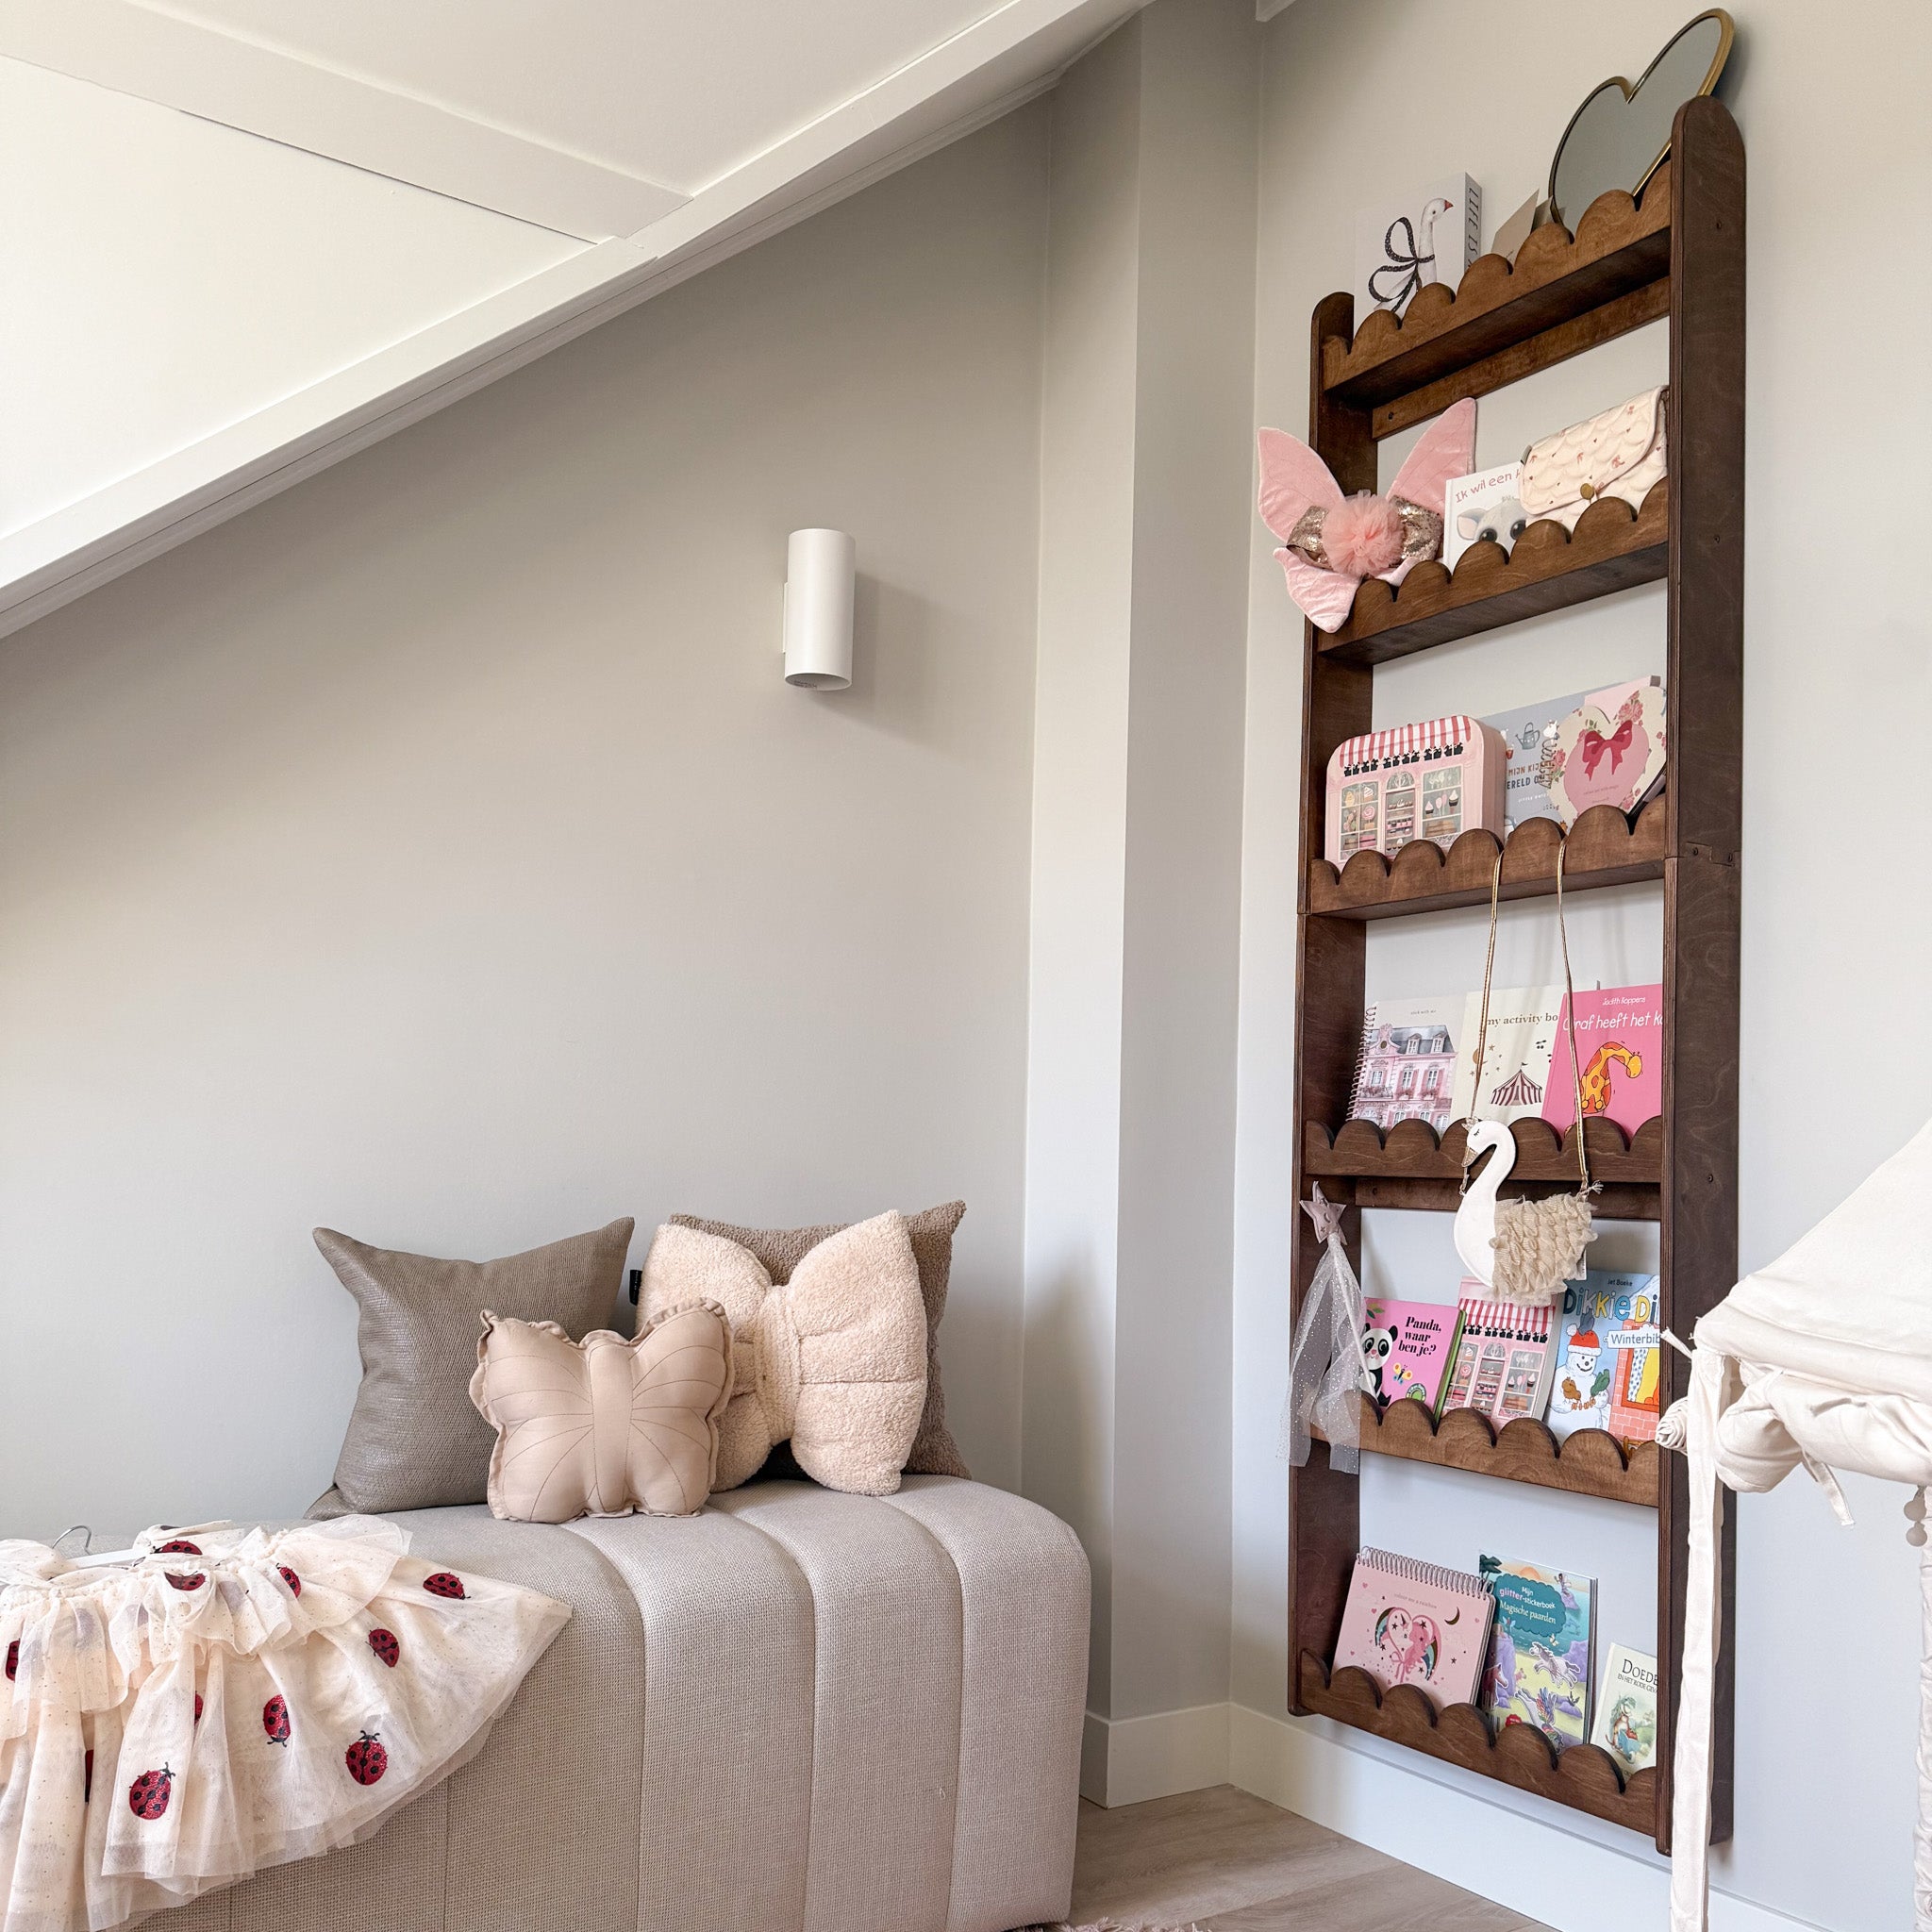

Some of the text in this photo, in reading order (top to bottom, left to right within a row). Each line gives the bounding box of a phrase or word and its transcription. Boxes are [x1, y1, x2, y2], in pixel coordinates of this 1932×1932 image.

[1468, 188, 1479, 230] LIFE
[1468, 234, 1478, 256] IS
[1455, 490, 1468, 503] Ik
[1470, 479, 1487, 494] wil
[1488, 473, 1512, 487] een
[1507, 762, 1540, 777] MIJN KIJ
[1507, 776, 1531, 790] ERELD
[1503, 1013, 1542, 1025] activity
[1545, 1012, 1558, 1022] bo
[1595, 1012, 1629, 1030] heeft
[1630, 1010, 1651, 1027] het
[1634, 1293, 1660, 1324] Di
[1406, 1316, 1441, 1333] Panda,
[1405, 1331, 1431, 1342] waar
[1610, 1332, 1660, 1344] Winterbib
[1398, 1340, 1437, 1357] ben je?
[1521, 1586, 1534, 1597] Mijn
[1500, 1600, 1557, 1624] Magische paarden
[1622, 1658, 1658, 1687] DOEDE
